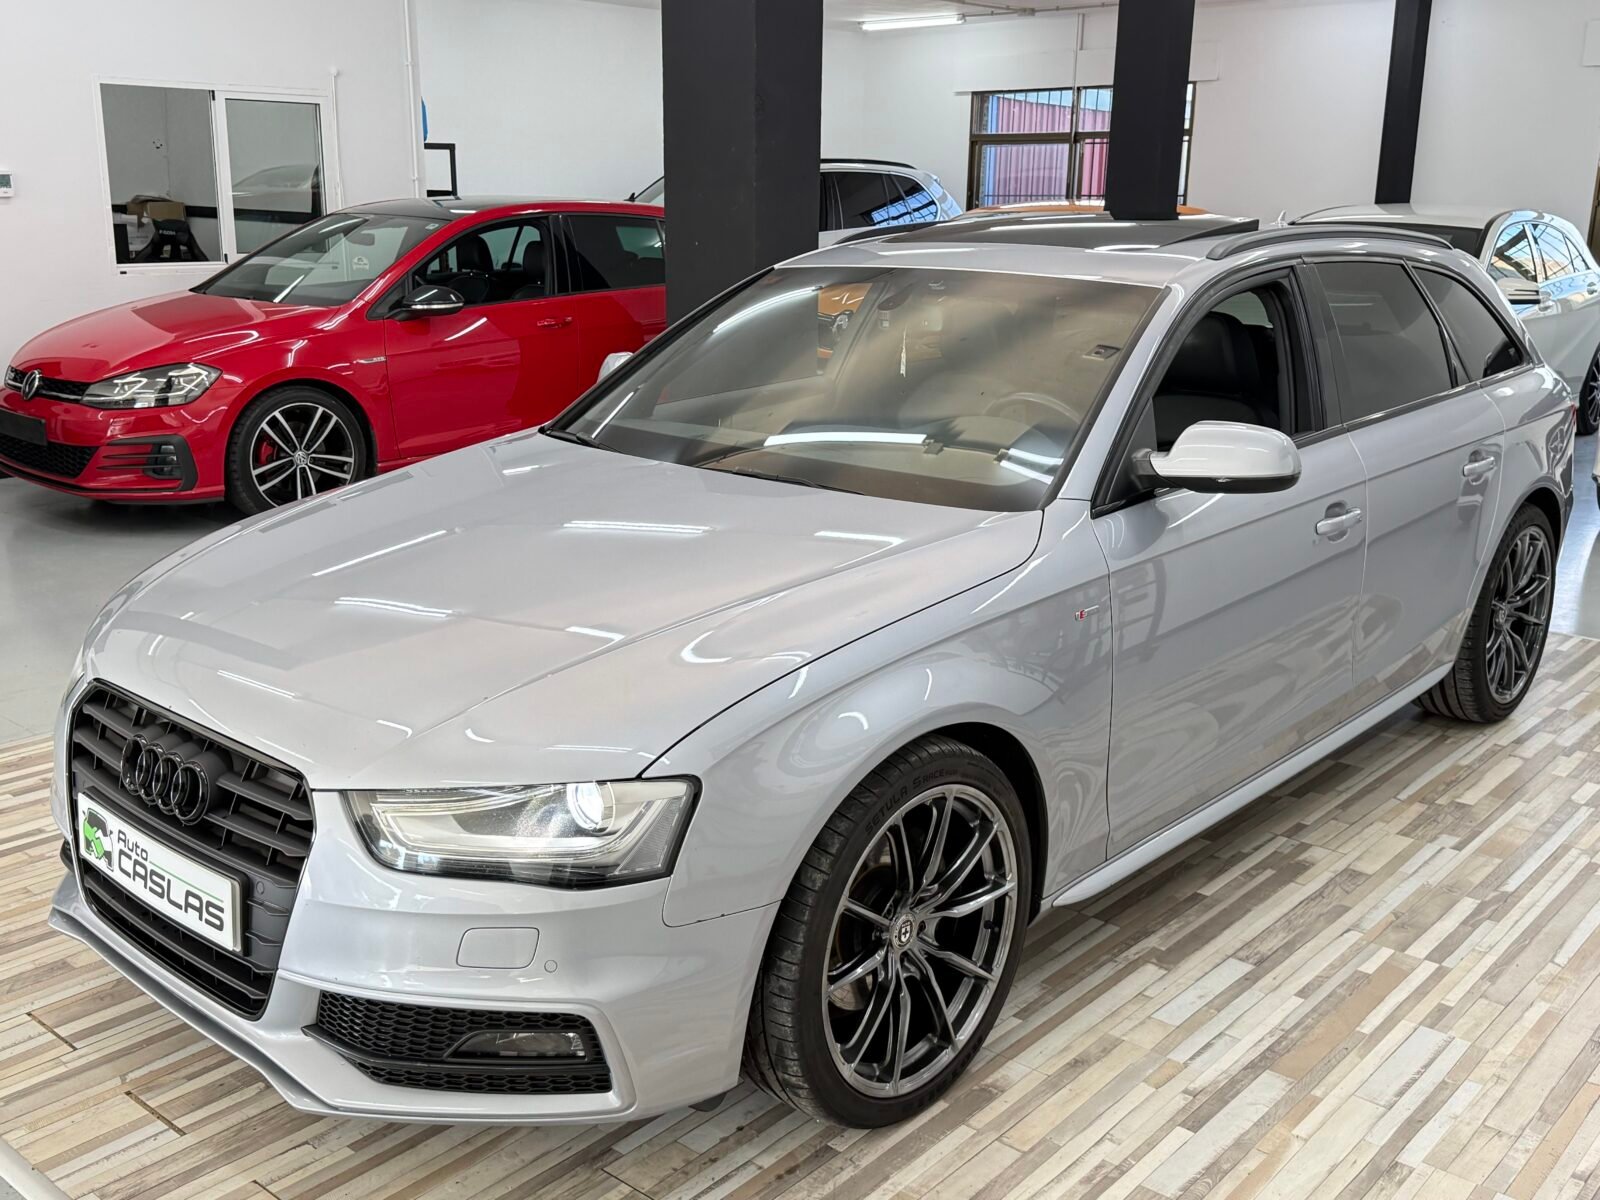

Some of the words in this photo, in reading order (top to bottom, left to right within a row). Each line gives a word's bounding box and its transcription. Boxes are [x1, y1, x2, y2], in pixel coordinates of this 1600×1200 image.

[865, 786, 908, 835] SETULA
[117, 829, 149, 862] Auto
[118, 848, 225, 932] CASLAS
